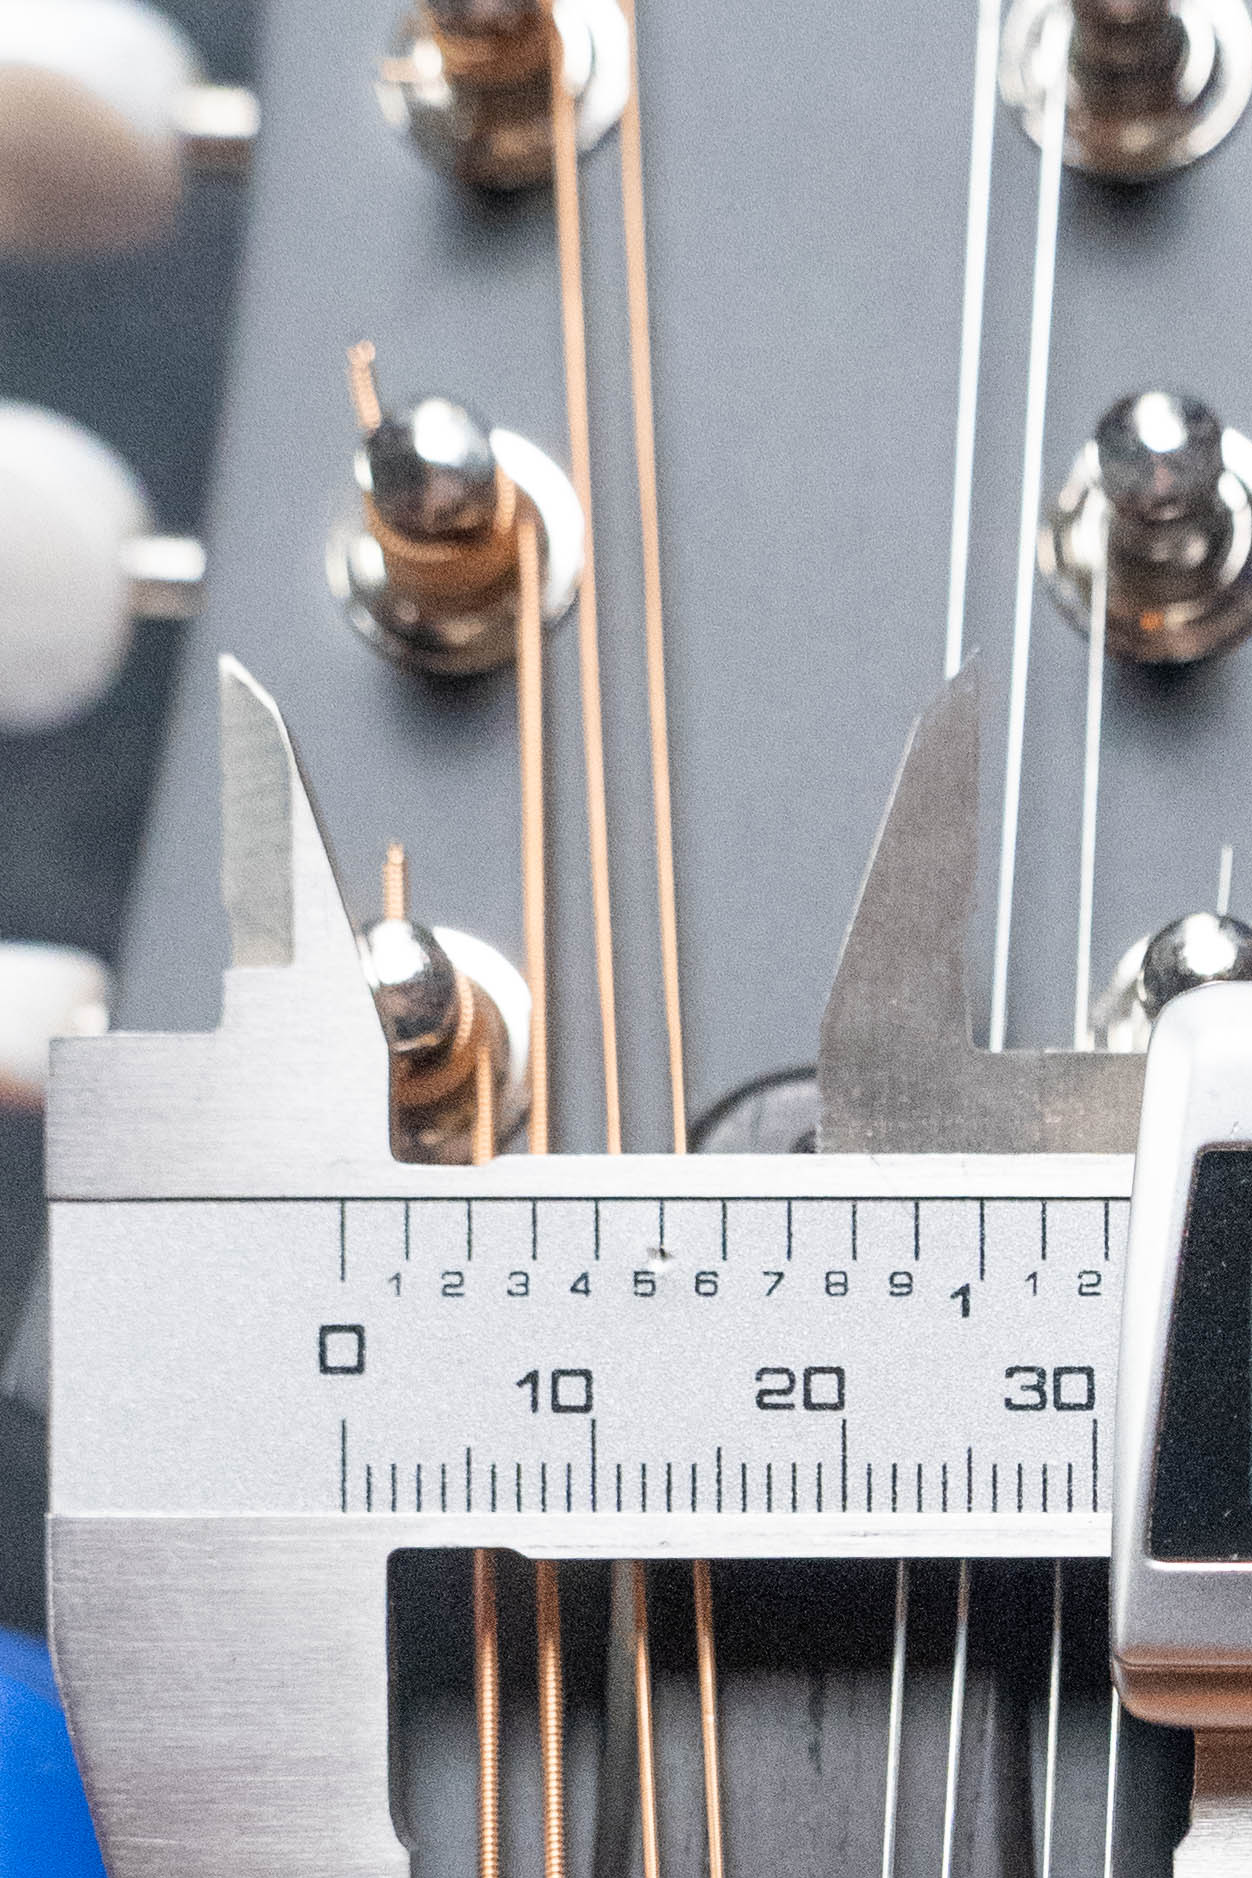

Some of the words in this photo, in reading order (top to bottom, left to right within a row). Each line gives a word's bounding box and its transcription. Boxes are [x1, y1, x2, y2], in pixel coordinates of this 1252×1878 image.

[387, 1270, 402, 1298] 1
[440, 1270, 465, 1298] 2
[506, 1270, 530, 1298] 3
[569, 1271, 593, 1298] 4
[632, 1269, 657, 1298] 5
[693, 1270, 720, 1298] 6
[762, 1270, 786, 1298] 7
[824, 1270, 850, 1298] 8
[888, 1270, 914, 1298] 9
[948, 1282, 971, 1319] 1
[1024, 1270, 1038, 1298] 1
[1077, 1269, 1103, 1298] 2
[317, 1323, 367, 1376] 0
[514, 1367, 594, 1415] 10
[754, 1365, 846, 1412] 20
[1002, 1364, 1096, 1412] 30
